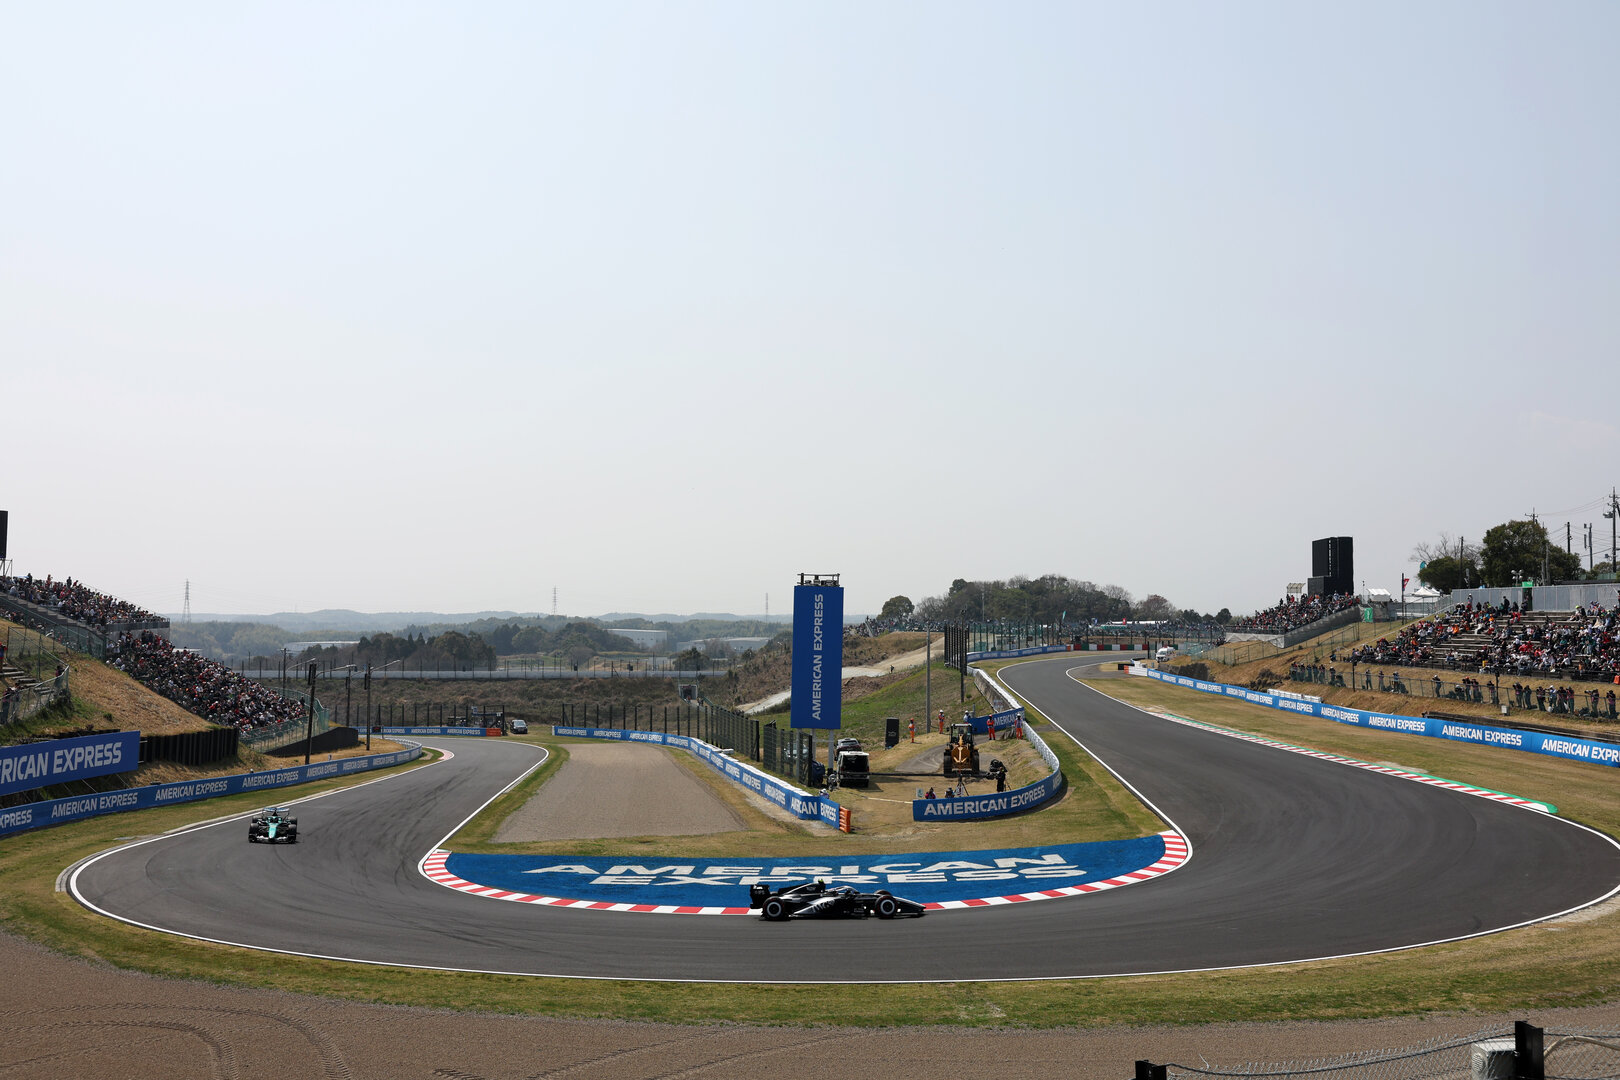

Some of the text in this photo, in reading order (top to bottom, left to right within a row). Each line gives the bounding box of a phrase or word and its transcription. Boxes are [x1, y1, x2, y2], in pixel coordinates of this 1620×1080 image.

[812, 593, 824, 720] AMERICAN EXPRESS
[1320, 706, 1359, 723] AMERICAN EXPRESS
[1368, 716, 1426, 732] AMERICAN EXPRESS
[1441, 724, 1522, 747] AMERICAN EXPRESS
[1541, 738, 1620, 763] AMERICAN EXPR
[0, 742, 122, 784] RICAN EXPRESS
[242, 770, 299, 788] AMERICAN EXPRESS
[155, 780, 228, 801] AMERICAN EXPRESS
[924, 784, 1045, 816] AMERICAN EXPRESS
[51, 792, 138, 818] AMERICAN EXPRESS
[521, 853, 1067, 875] AMERICAN
[589, 865, 1088, 886] EXPRESS
